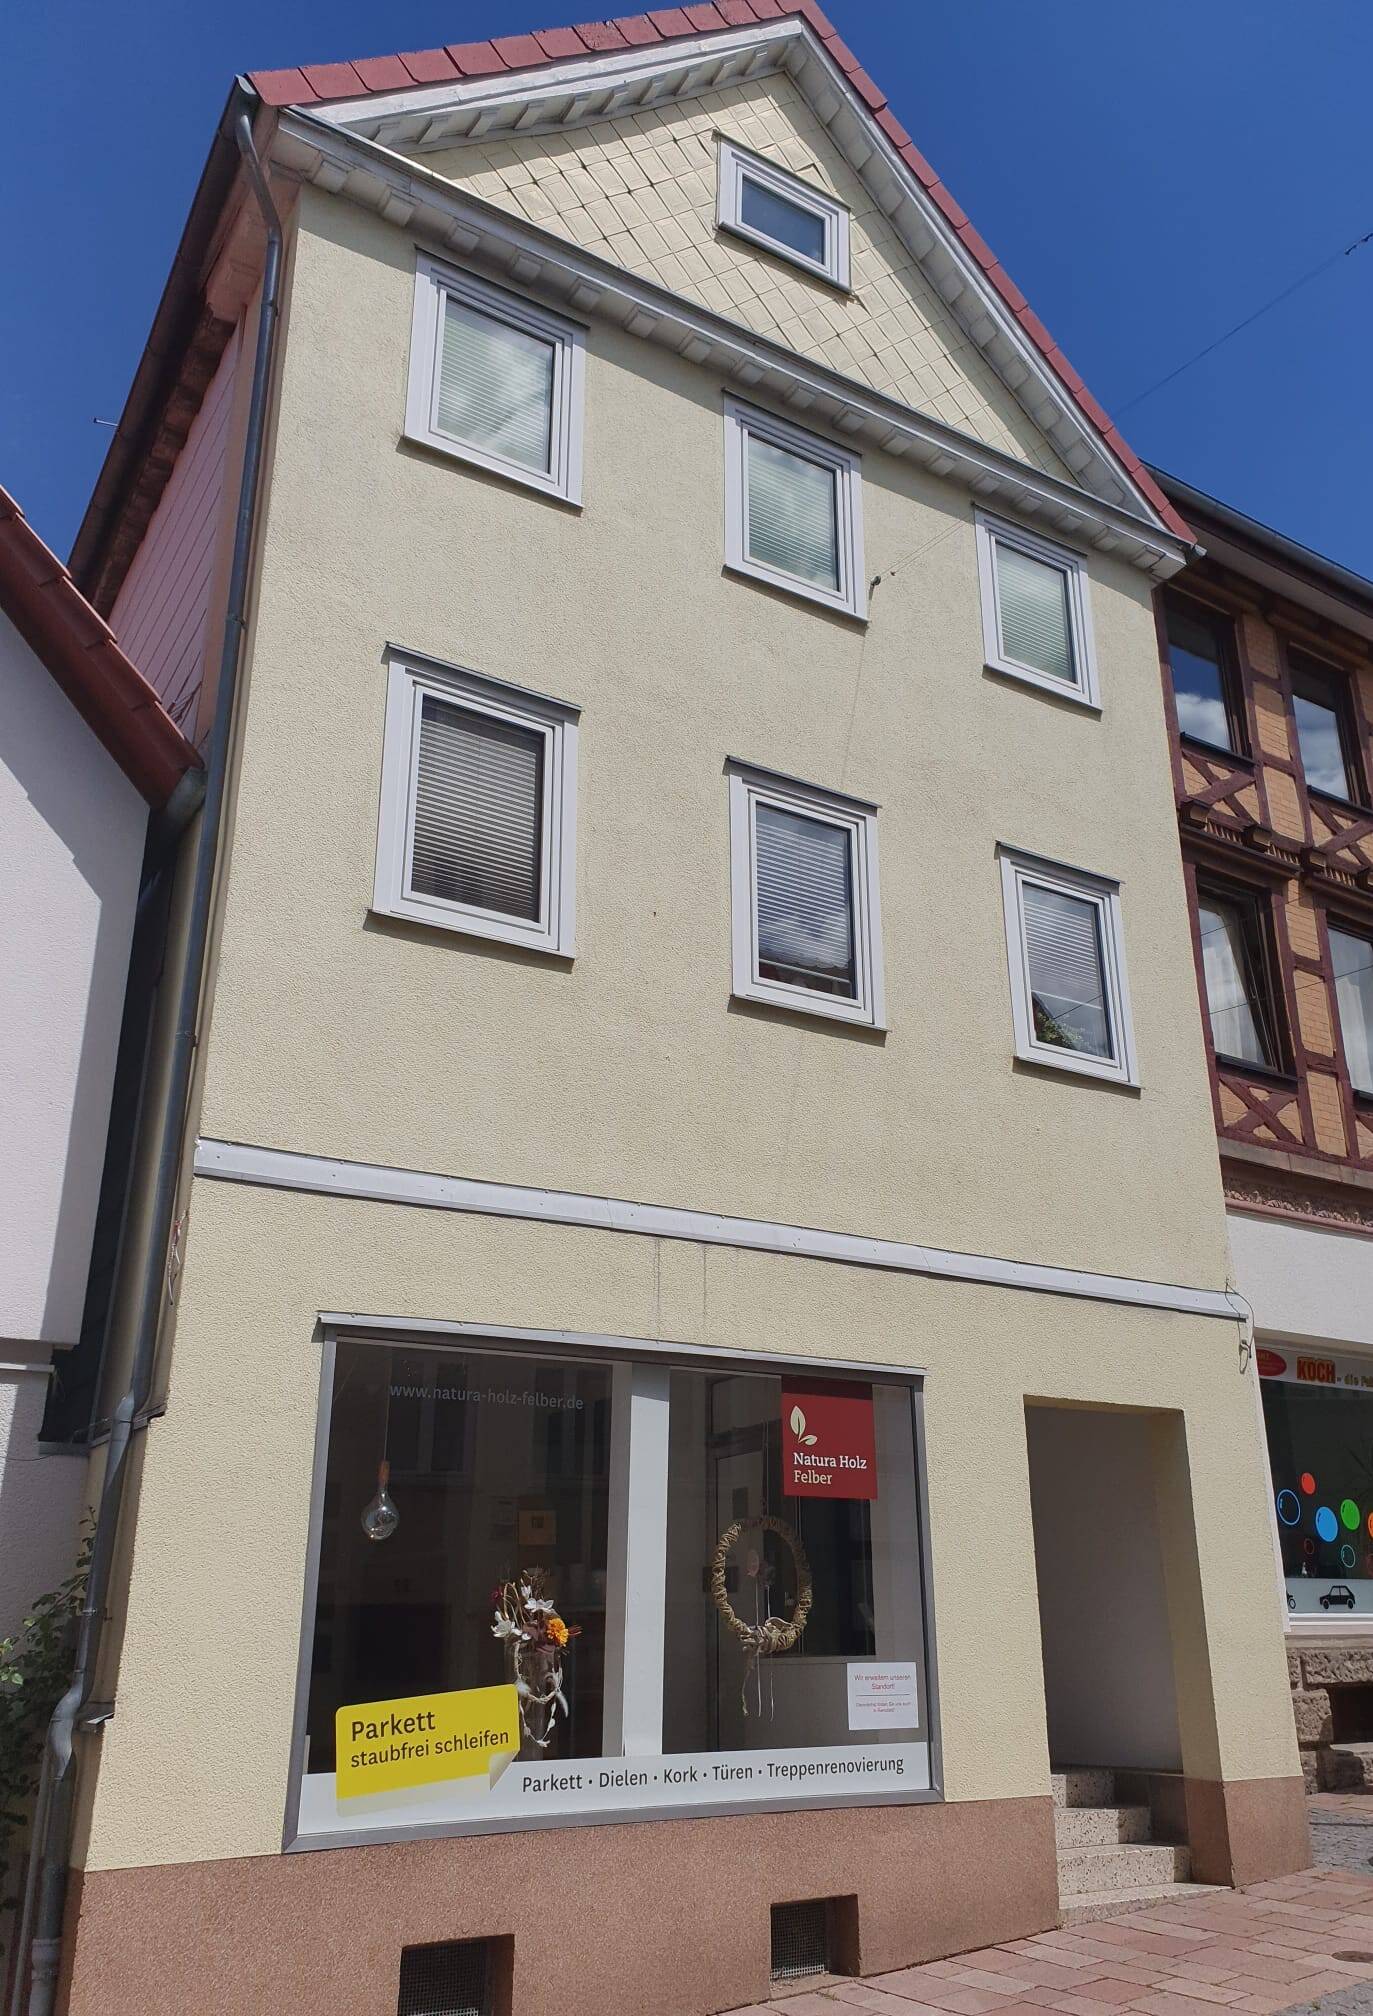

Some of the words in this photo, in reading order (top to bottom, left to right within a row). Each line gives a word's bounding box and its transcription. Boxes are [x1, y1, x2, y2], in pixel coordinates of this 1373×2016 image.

[1296, 1356, 1336, 1384] KOCH
[390, 1384, 584, 1410] www.natura-holz-felber.de
[793, 1452, 837, 1467] Natura
[839, 1455, 867, 1469] Holz
[793, 1469, 833, 1485] Felber
[352, 1711, 436, 1742] Parkett
[351, 1739, 430, 1768] staubfrei
[434, 1730, 509, 1755] schleifen
[522, 1774, 583, 1793] Parkett
[600, 1770, 648, 1788] Dielen
[663, 1766, 698, 1784] Kork
[712, 1764, 753, 1781] Türen
[767, 1756, 904, 1780] Treppenrenovierung
